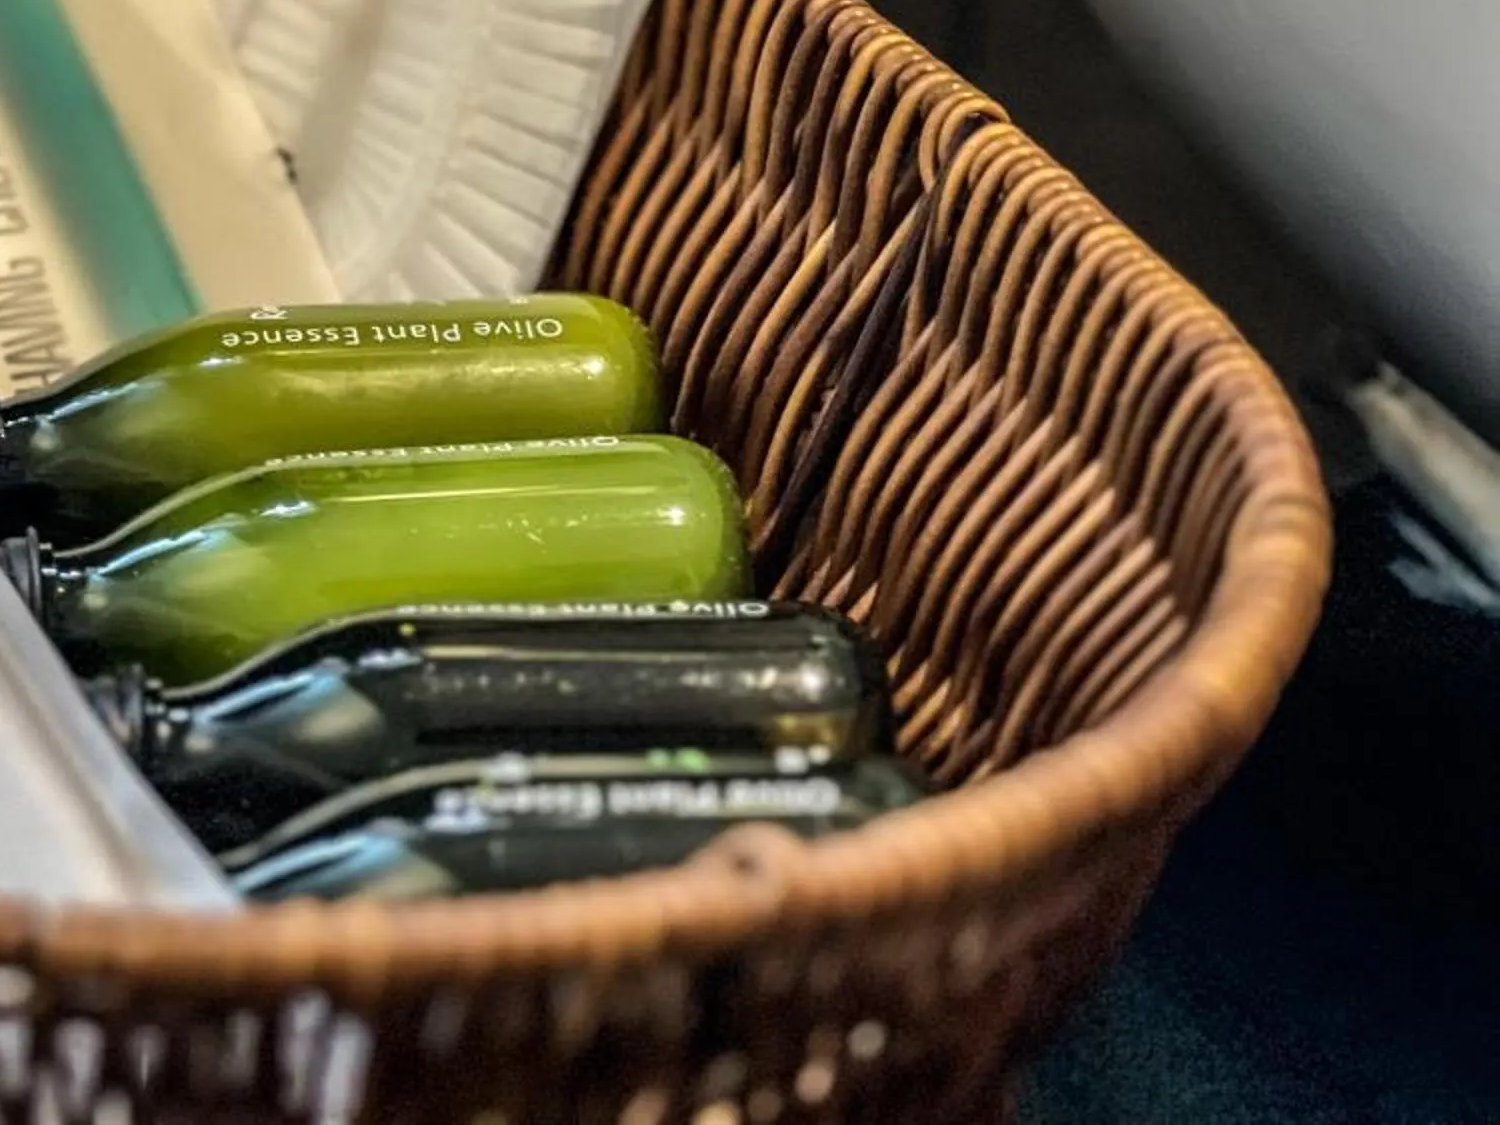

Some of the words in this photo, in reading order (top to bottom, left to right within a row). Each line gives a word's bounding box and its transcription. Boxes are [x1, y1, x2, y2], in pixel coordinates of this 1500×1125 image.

[219, 326, 360, 350] Essence
[372, 321, 461, 344] Plant
[473, 316, 563, 341] Olive
[557, 602, 655, 618] Plant
[667, 600, 770, 618] Olive
